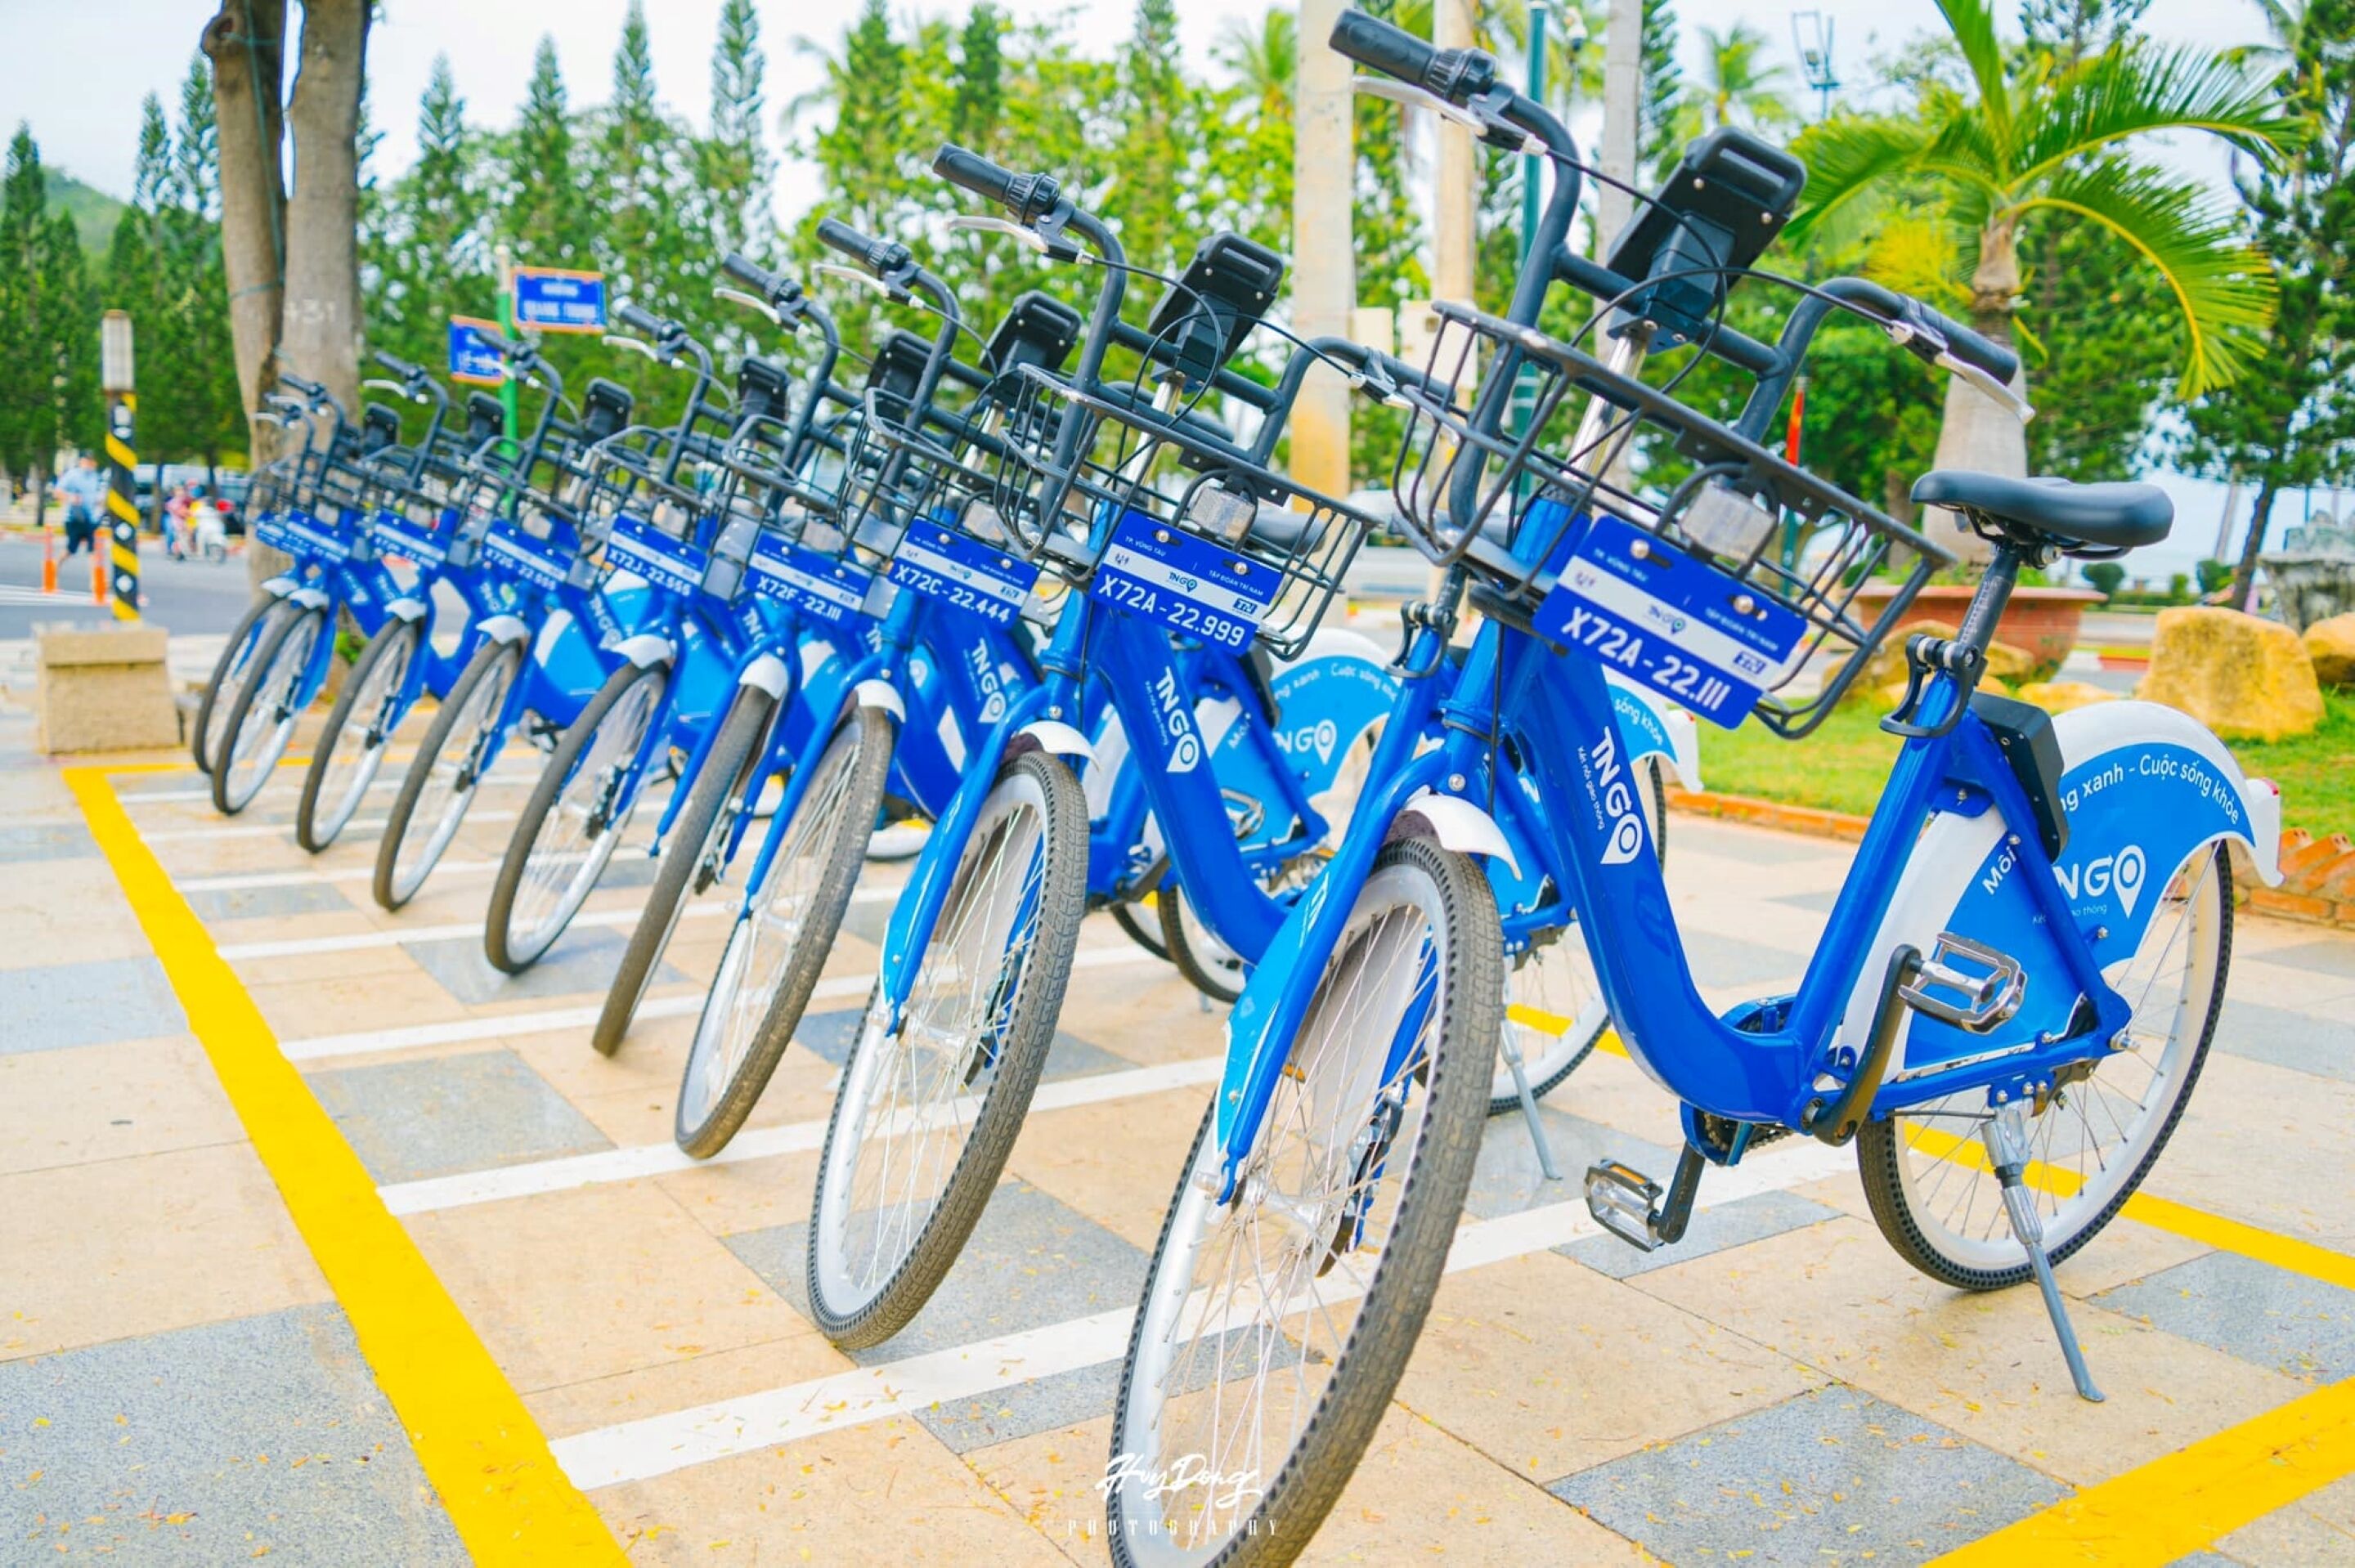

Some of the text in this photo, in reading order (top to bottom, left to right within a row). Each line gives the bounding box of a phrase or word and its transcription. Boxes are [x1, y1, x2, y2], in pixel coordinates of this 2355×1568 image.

[1098, 574, 1245, 647] X72A-22.999
[971, 637, 1007, 724] TNGO
[1155, 665, 1200, 773] TNGO
[1591, 726, 1643, 864] TNGO
[2082, 763, 2124, 798] xanh
[2139, 753, 2178, 781] Cuộc
[2179, 759, 2212, 798] sống
[2212, 780, 2239, 826] khỏe
[1982, 845, 2016, 895] Môi
[2052, 844, 2146, 919] NGO
